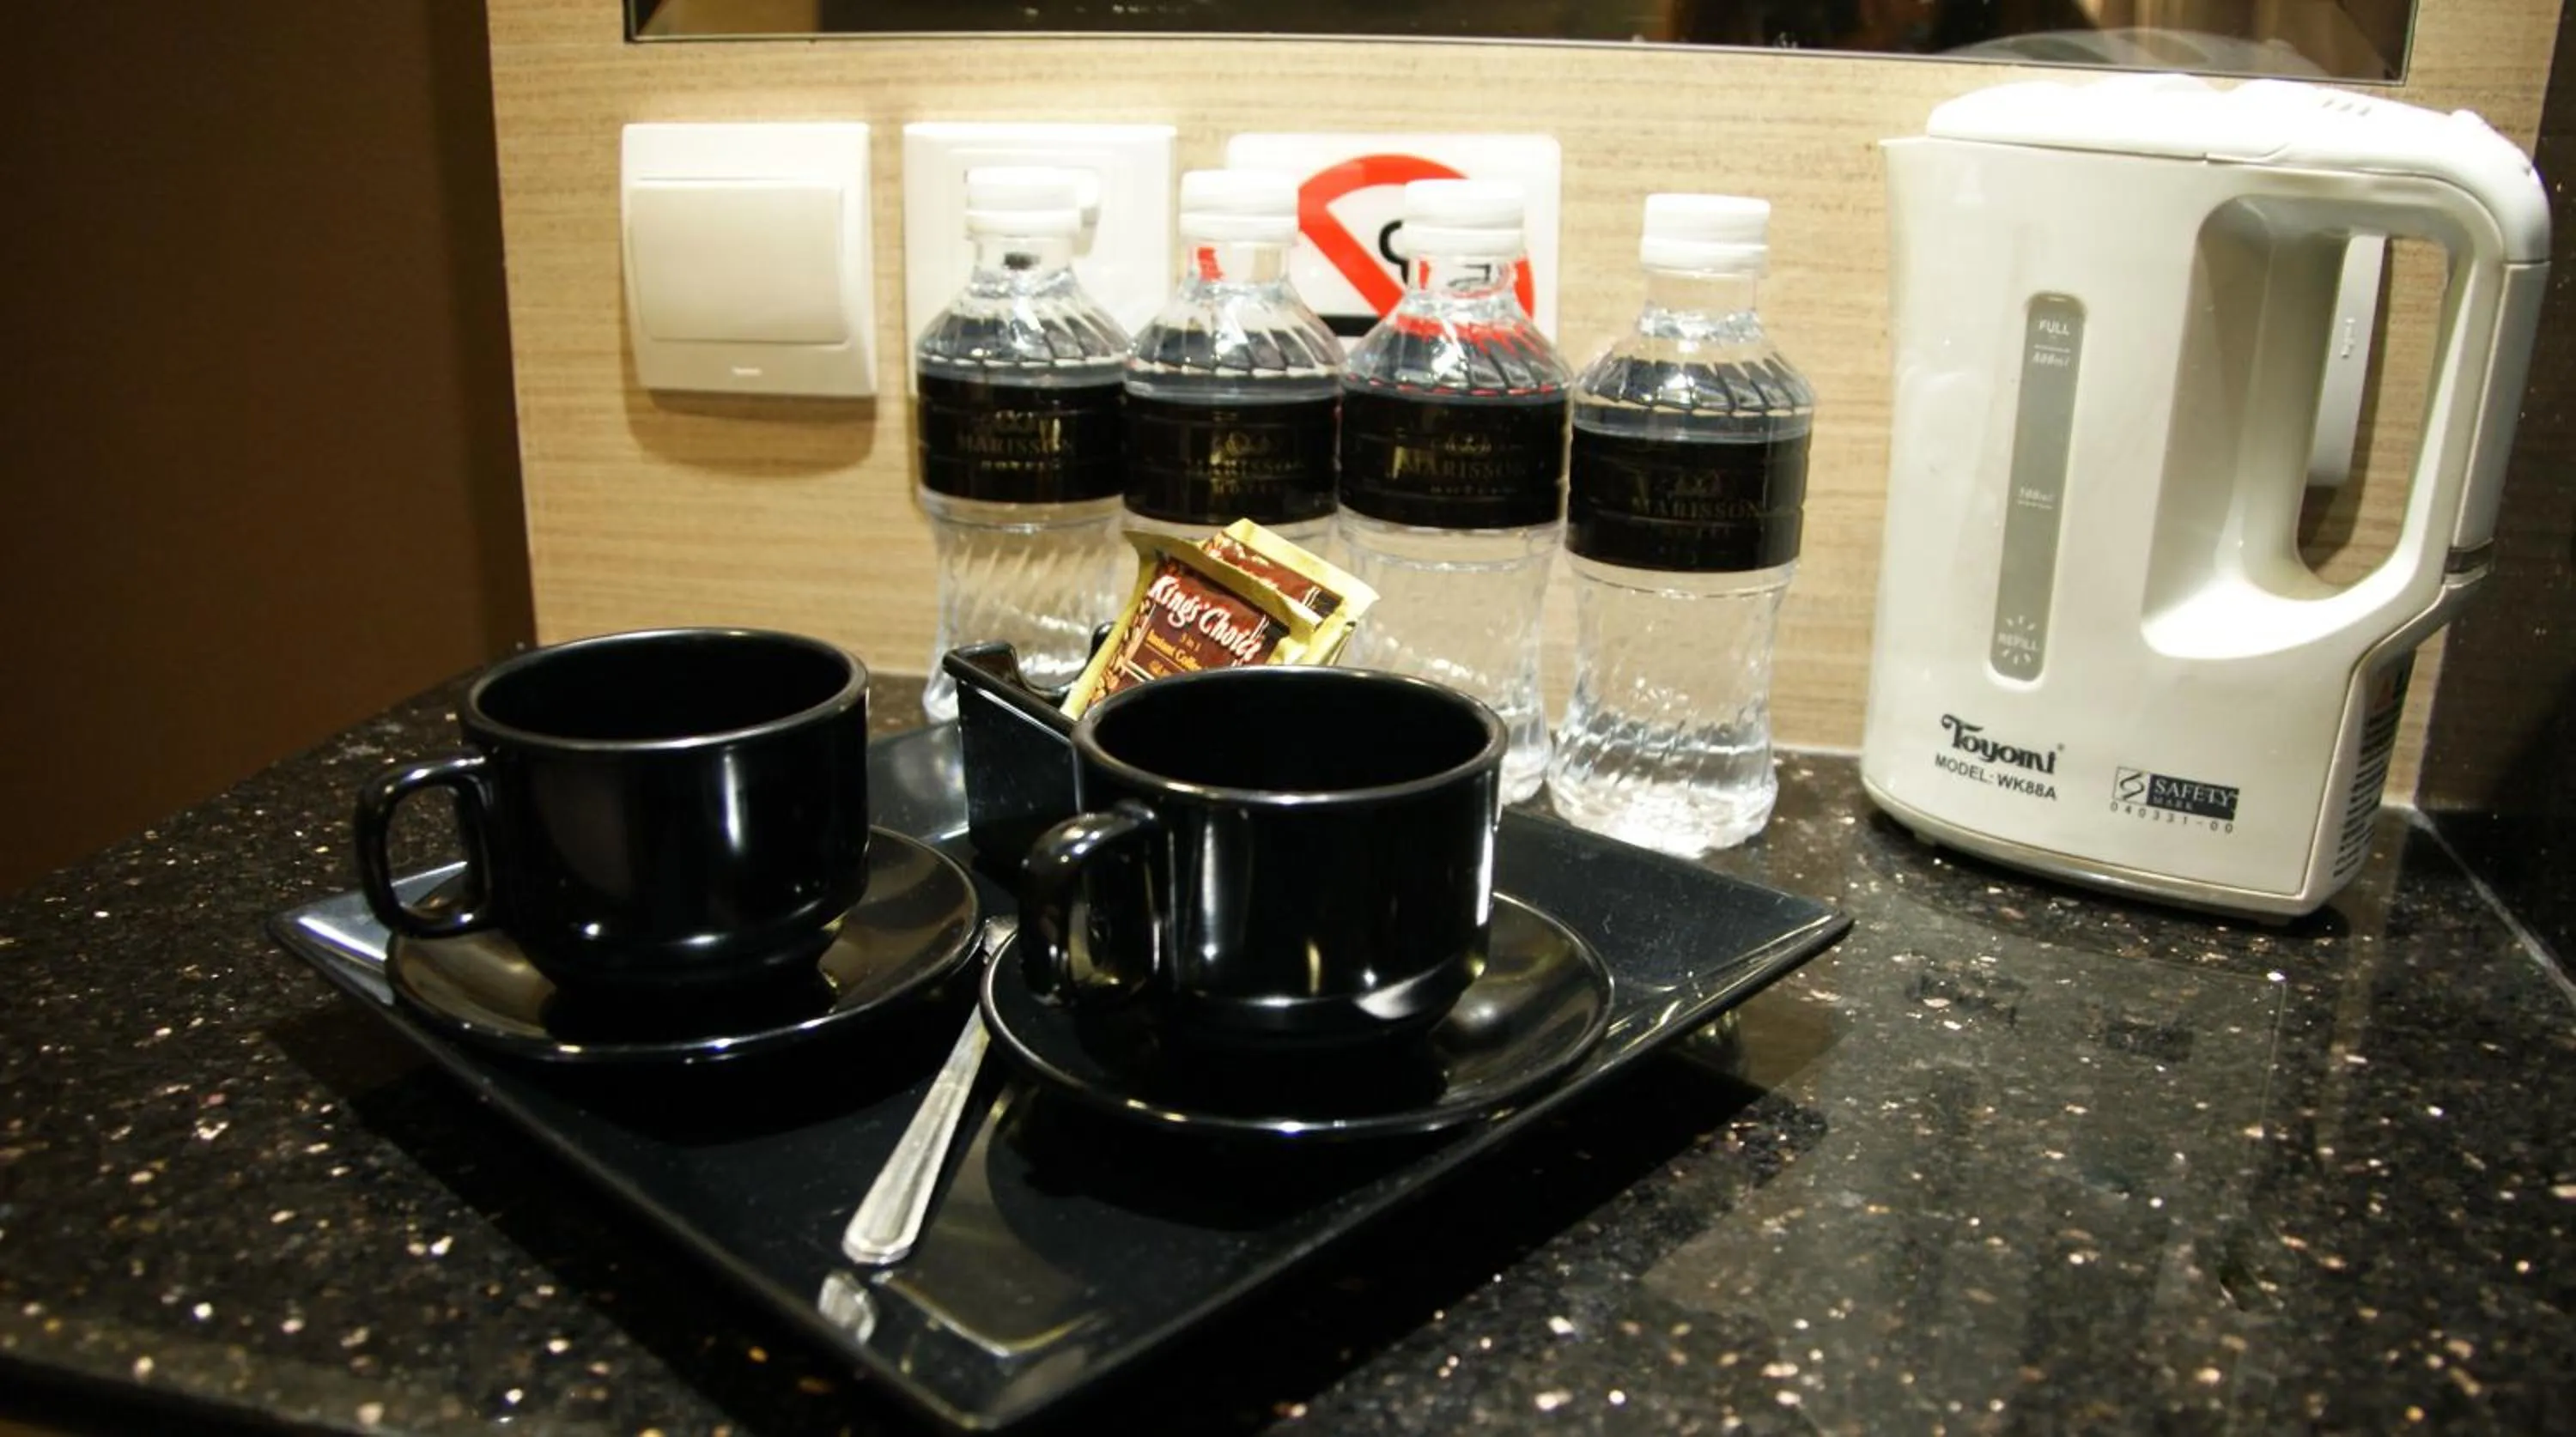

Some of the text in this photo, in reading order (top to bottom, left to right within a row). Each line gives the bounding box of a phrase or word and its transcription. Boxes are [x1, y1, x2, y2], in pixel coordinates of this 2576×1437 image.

[2039, 319, 2070, 336] FULL
[1199, 607, 1266, 663] Choice
[1941, 713, 2057, 775] Toyomi
[1996, 773, 2057, 801] WK88A
[2154, 778, 2231, 808] SAFETY
